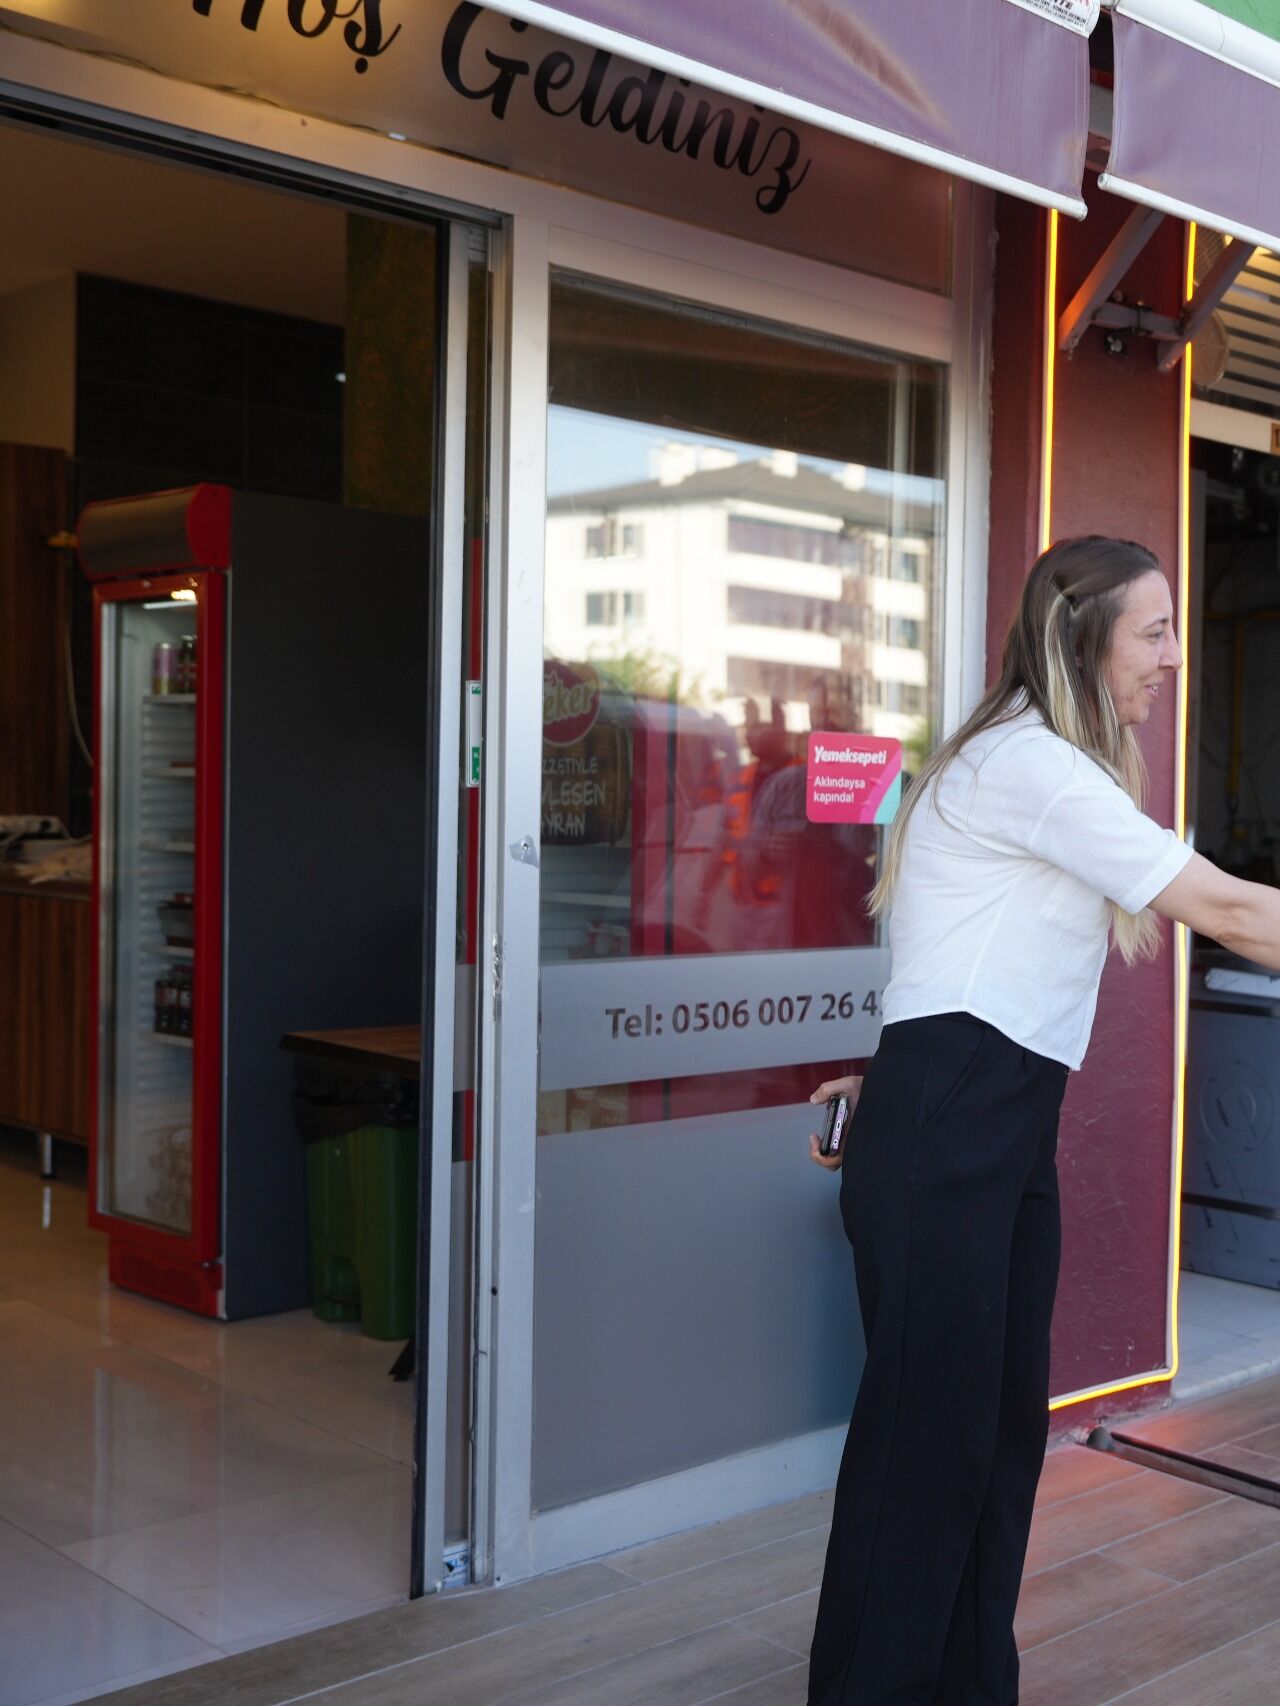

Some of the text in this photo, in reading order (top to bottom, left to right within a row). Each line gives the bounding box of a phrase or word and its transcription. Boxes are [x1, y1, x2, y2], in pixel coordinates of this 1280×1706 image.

[192, 0, 812, 215] oş Geldiniz
[814, 745, 888, 767] Yemeksepeti
[605, 990, 883, 1039] Tel: 0506 007 26 4
